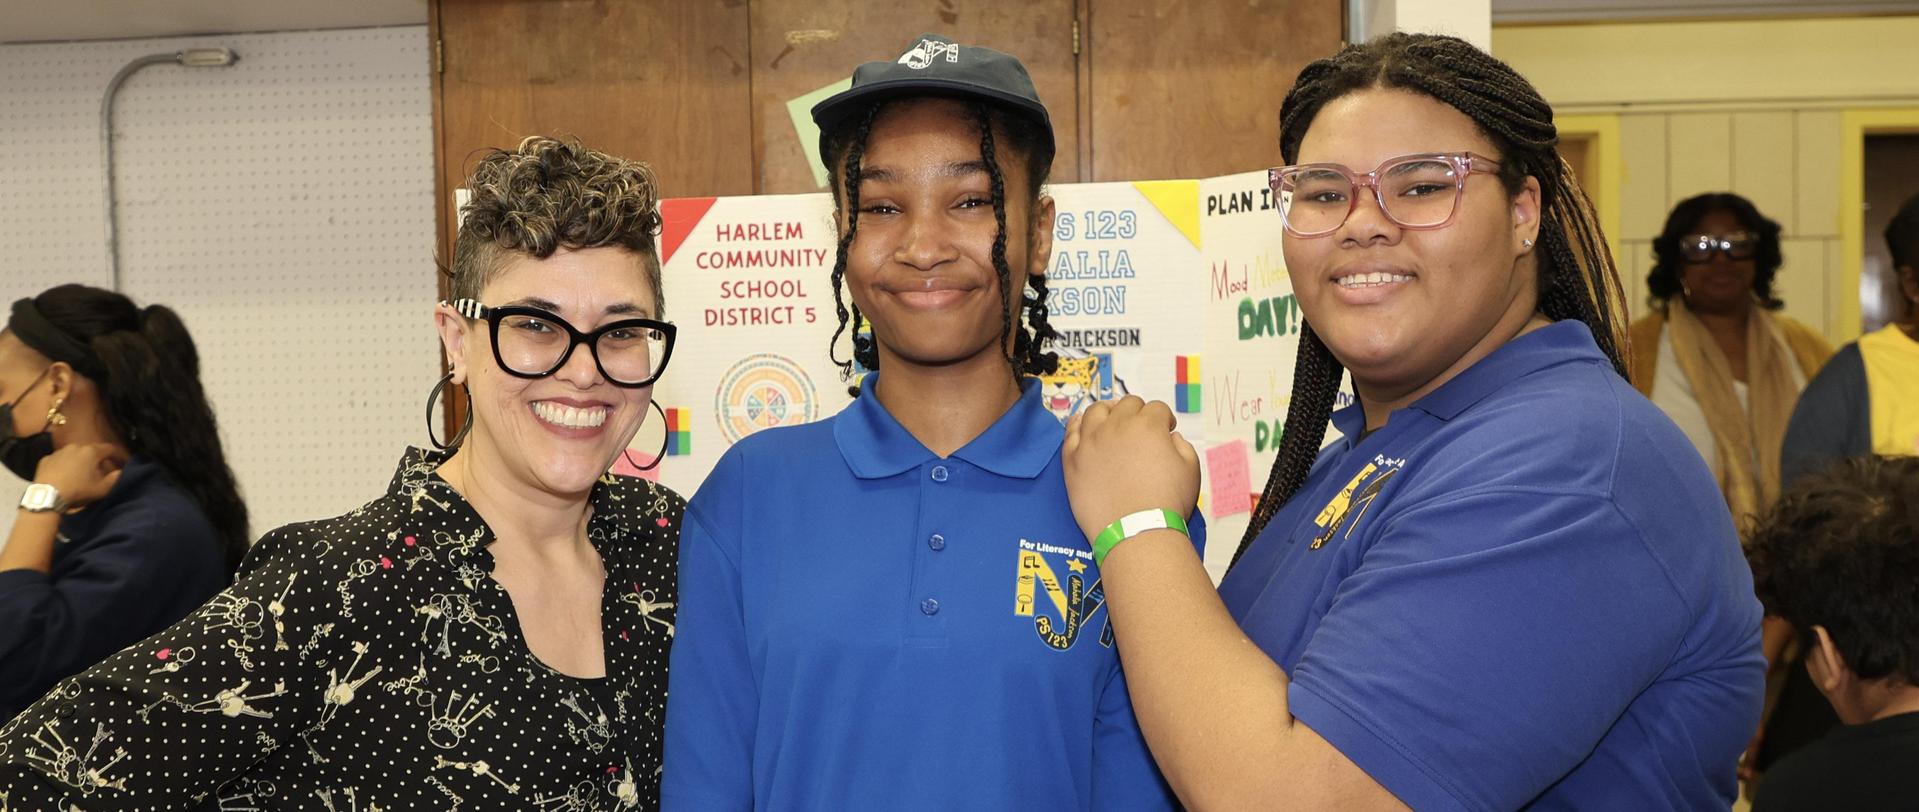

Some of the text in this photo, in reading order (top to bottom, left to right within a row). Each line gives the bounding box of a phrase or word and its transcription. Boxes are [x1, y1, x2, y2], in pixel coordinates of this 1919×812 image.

[1207, 191, 1253, 216] PLAN
[716, 222, 803, 242] HARLEM
[1051, 210, 1137, 241] S 123
[696, 249, 827, 269] COMMUNITY
[1046, 250, 1135, 279] ALIA
[720, 280, 807, 299] SCHOOL
[1211, 259, 1248, 303] Mood
[704, 307, 817, 326] DISTRICT 5
[1238, 294, 1298, 340] DAY!
[1064, 329, 1141, 348] JACKSON
[1212, 369, 1263, 426] Wear
[1019, 538, 1094, 561] For Literacy and
[1036, 617, 1069, 650] PS 123
